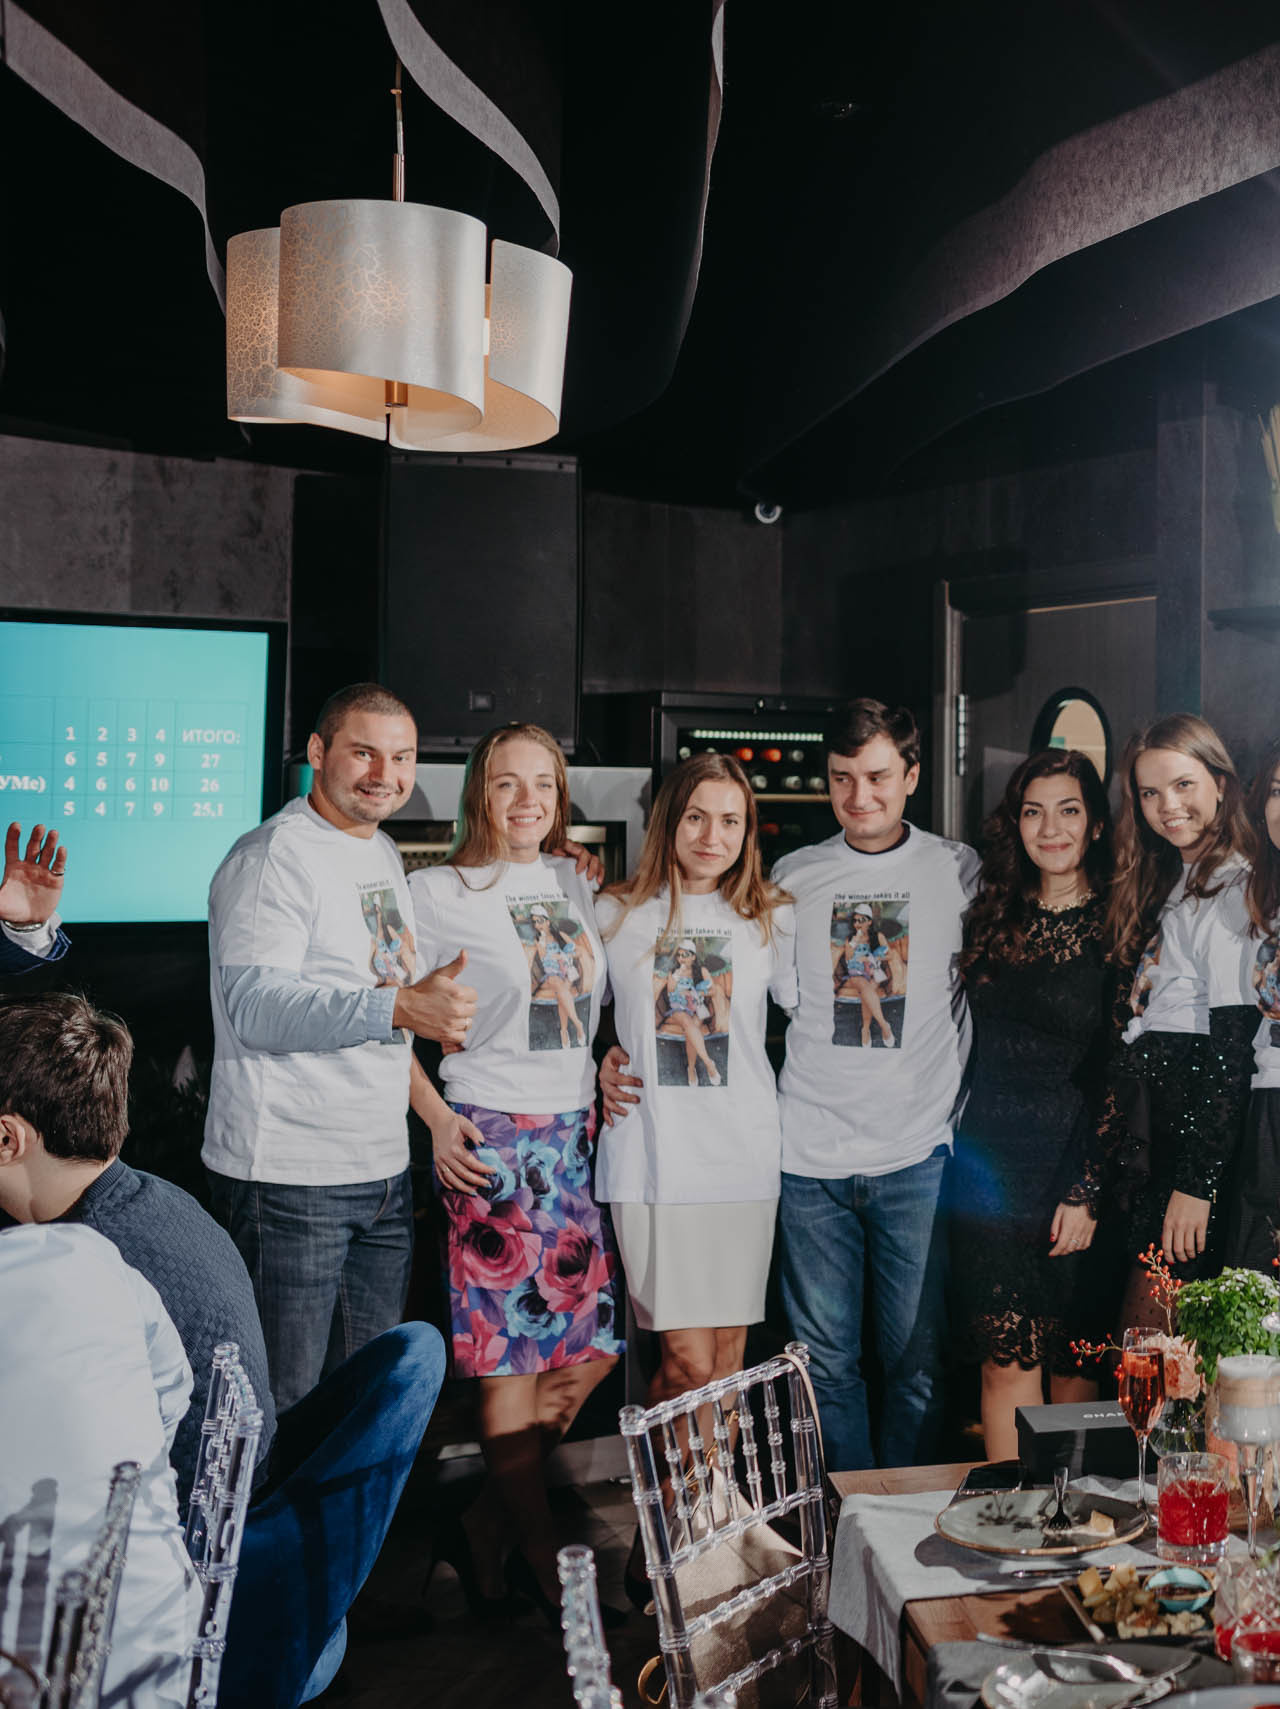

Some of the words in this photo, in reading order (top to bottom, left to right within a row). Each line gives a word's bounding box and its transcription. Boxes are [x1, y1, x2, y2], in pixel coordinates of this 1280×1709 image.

[65, 726, 76, 741] 1
[97, 727, 108, 742] 2
[127, 728, 137, 742] 3
[155, 728, 166, 743] 4
[182, 728, 240, 744] ИТОГО:
[65, 752, 76, 767] 6
[96, 752, 108, 767] 5
[125, 752, 137, 767] 7
[154, 753, 165, 768] 9
[201, 753, 221, 768] 27
[64, 776, 75, 792] 4
[96, 777, 107, 792] 6
[125, 777, 136, 792] 6
[150, 777, 169, 792] 10
[201, 778, 219, 793] 26
[64, 801, 75, 816] 5
[95, 802, 106, 817] 4
[125, 802, 136, 817] 7
[153, 802, 164, 817] 9
